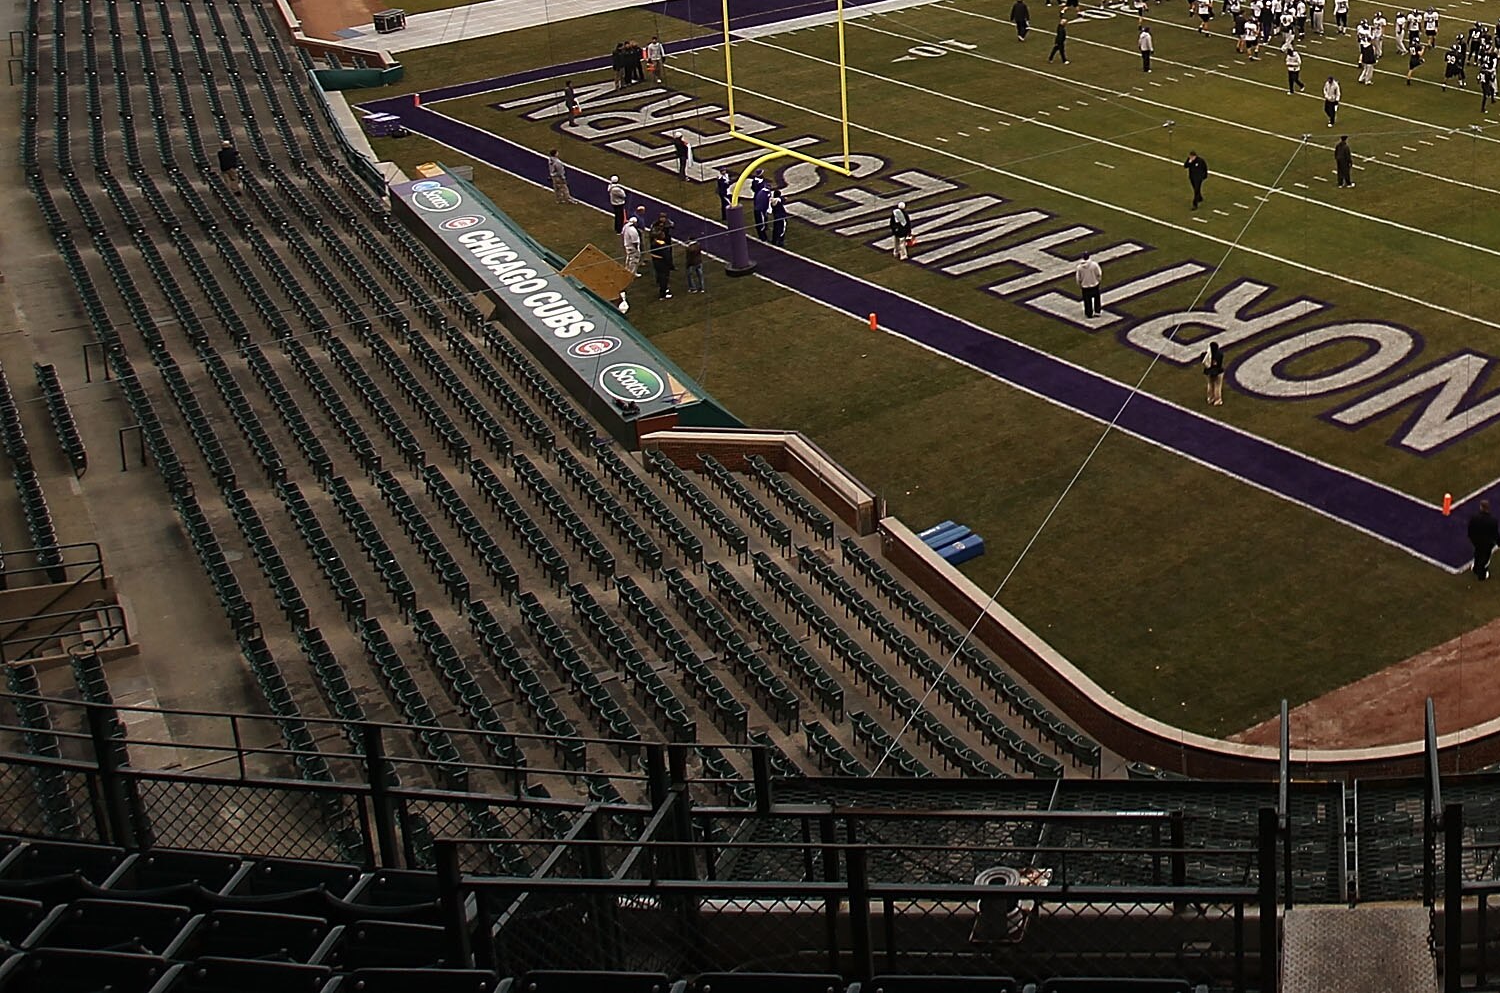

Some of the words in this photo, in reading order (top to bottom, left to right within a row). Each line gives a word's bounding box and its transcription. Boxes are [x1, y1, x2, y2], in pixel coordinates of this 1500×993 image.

[908, 38, 978, 58] 10
[458, 229, 549, 294] CHICAGO
[522, 291, 595, 339] CUBS
